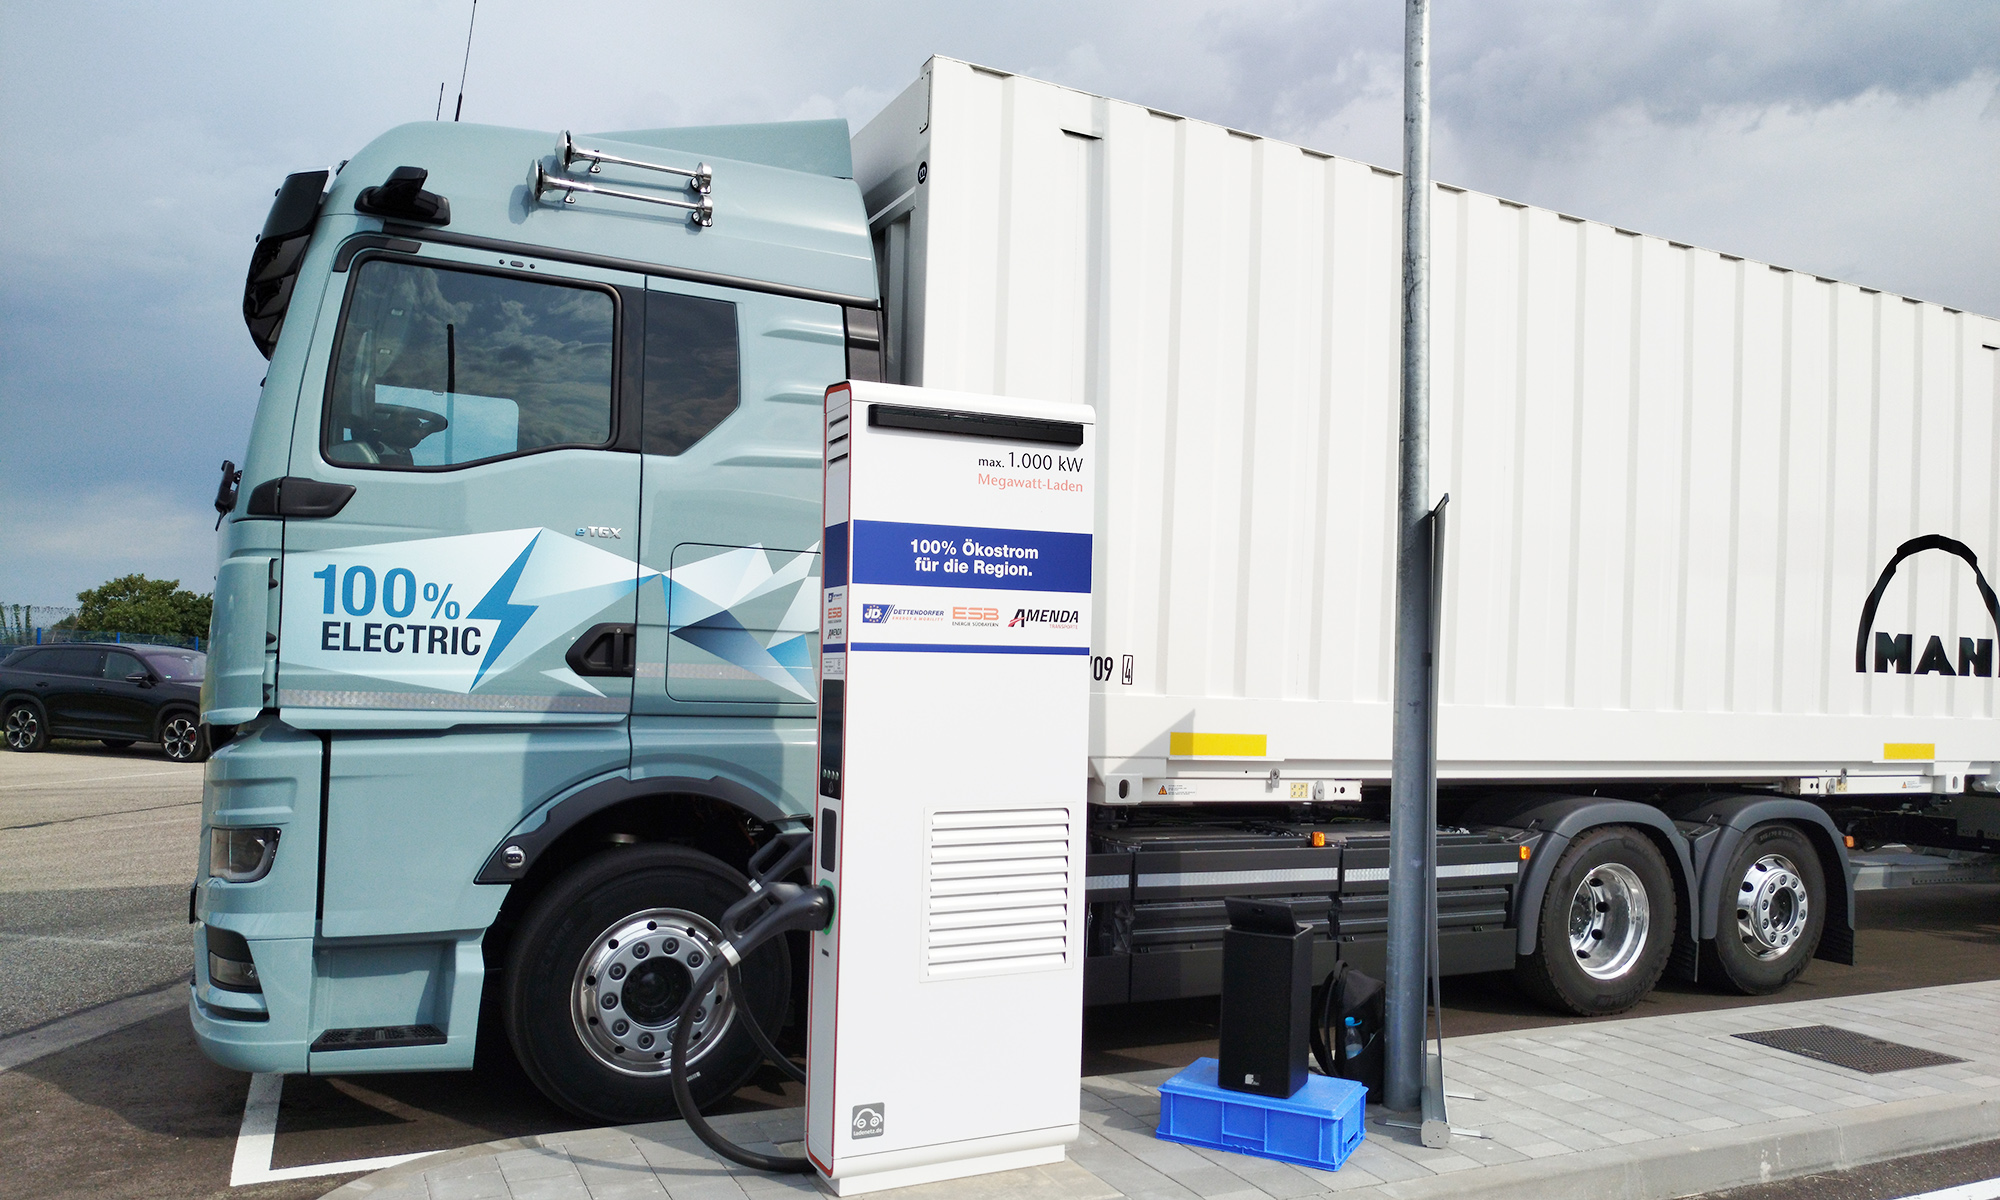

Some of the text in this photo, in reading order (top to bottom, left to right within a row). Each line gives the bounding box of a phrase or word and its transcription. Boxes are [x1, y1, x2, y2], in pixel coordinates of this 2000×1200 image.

[978, 452, 1084, 473] max. 1.000 kW
[978, 473, 1083, 492] Megawatt-Laden
[575, 525, 622, 540] eTGX
[910, 538, 1039, 560] 100% Ökostrom
[914, 556, 1033, 578] für die Region.
[828, 606, 842, 619] ESB
[864, 608, 881, 619] JD
[893, 608, 945, 616] DETTENDORFER
[952, 606, 999, 621] ESB
[1008, 608, 1079, 628] AMENDA
[321, 621, 482, 656] ELECTRIC
[1874, 631, 1993, 678] MAN
